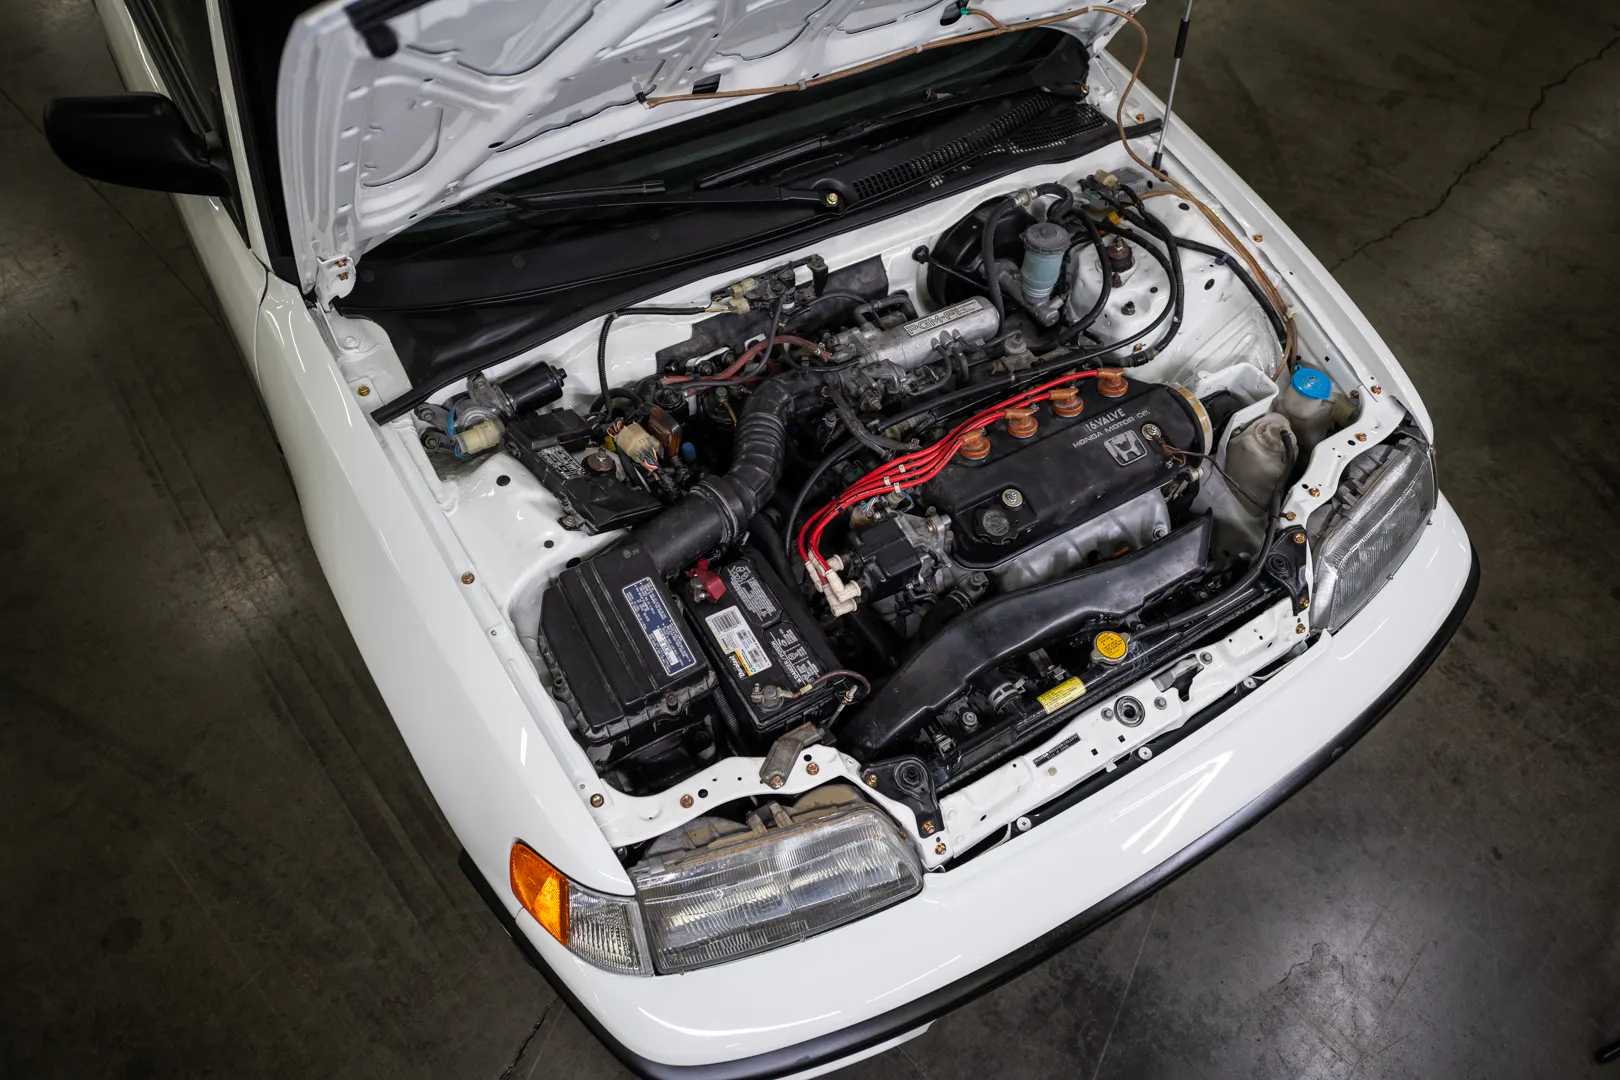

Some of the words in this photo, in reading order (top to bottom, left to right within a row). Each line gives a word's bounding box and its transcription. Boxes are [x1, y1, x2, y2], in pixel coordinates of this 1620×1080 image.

[905, 307, 961, 334] PGM-FI
[1072, 432, 1103, 448] HONDA
[1104, 416, 1135, 433] MOTOR
